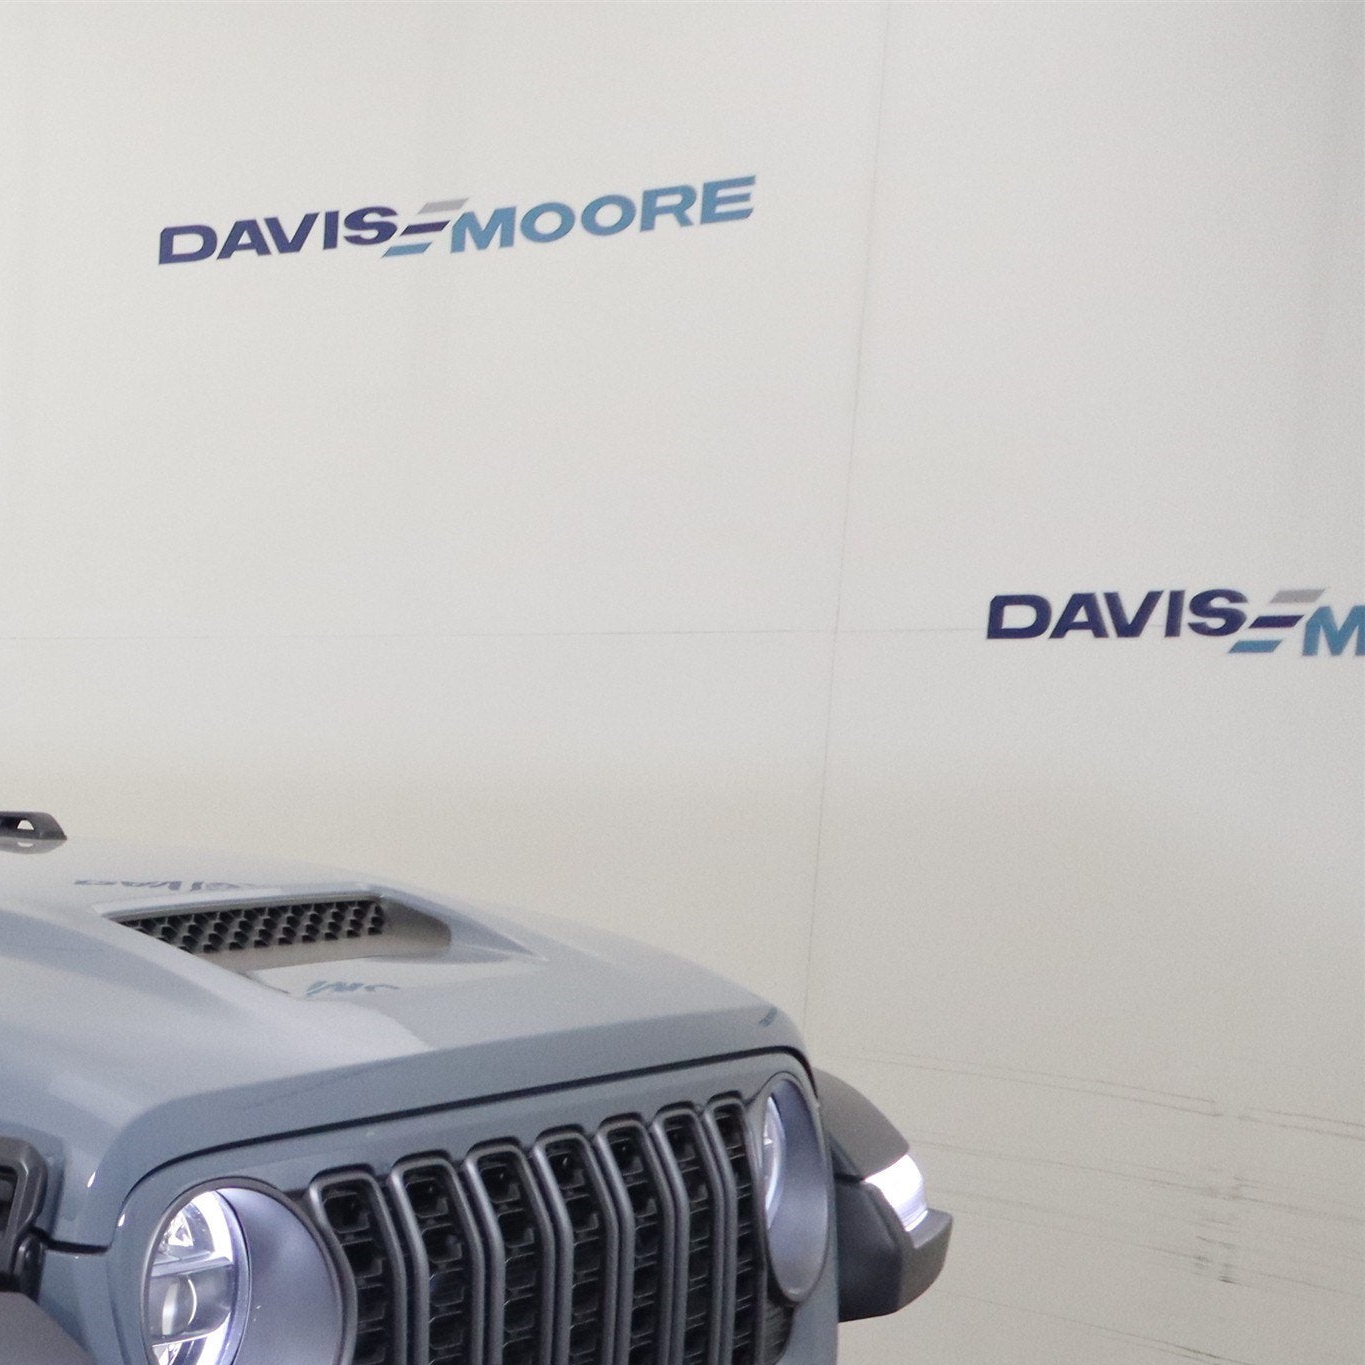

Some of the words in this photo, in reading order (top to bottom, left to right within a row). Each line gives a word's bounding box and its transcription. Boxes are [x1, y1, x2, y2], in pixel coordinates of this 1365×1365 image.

[158, 206, 398, 265] DAVIS
[450, 175, 756, 253] MOORE
[986, 589, 1249, 639] DAVIS
